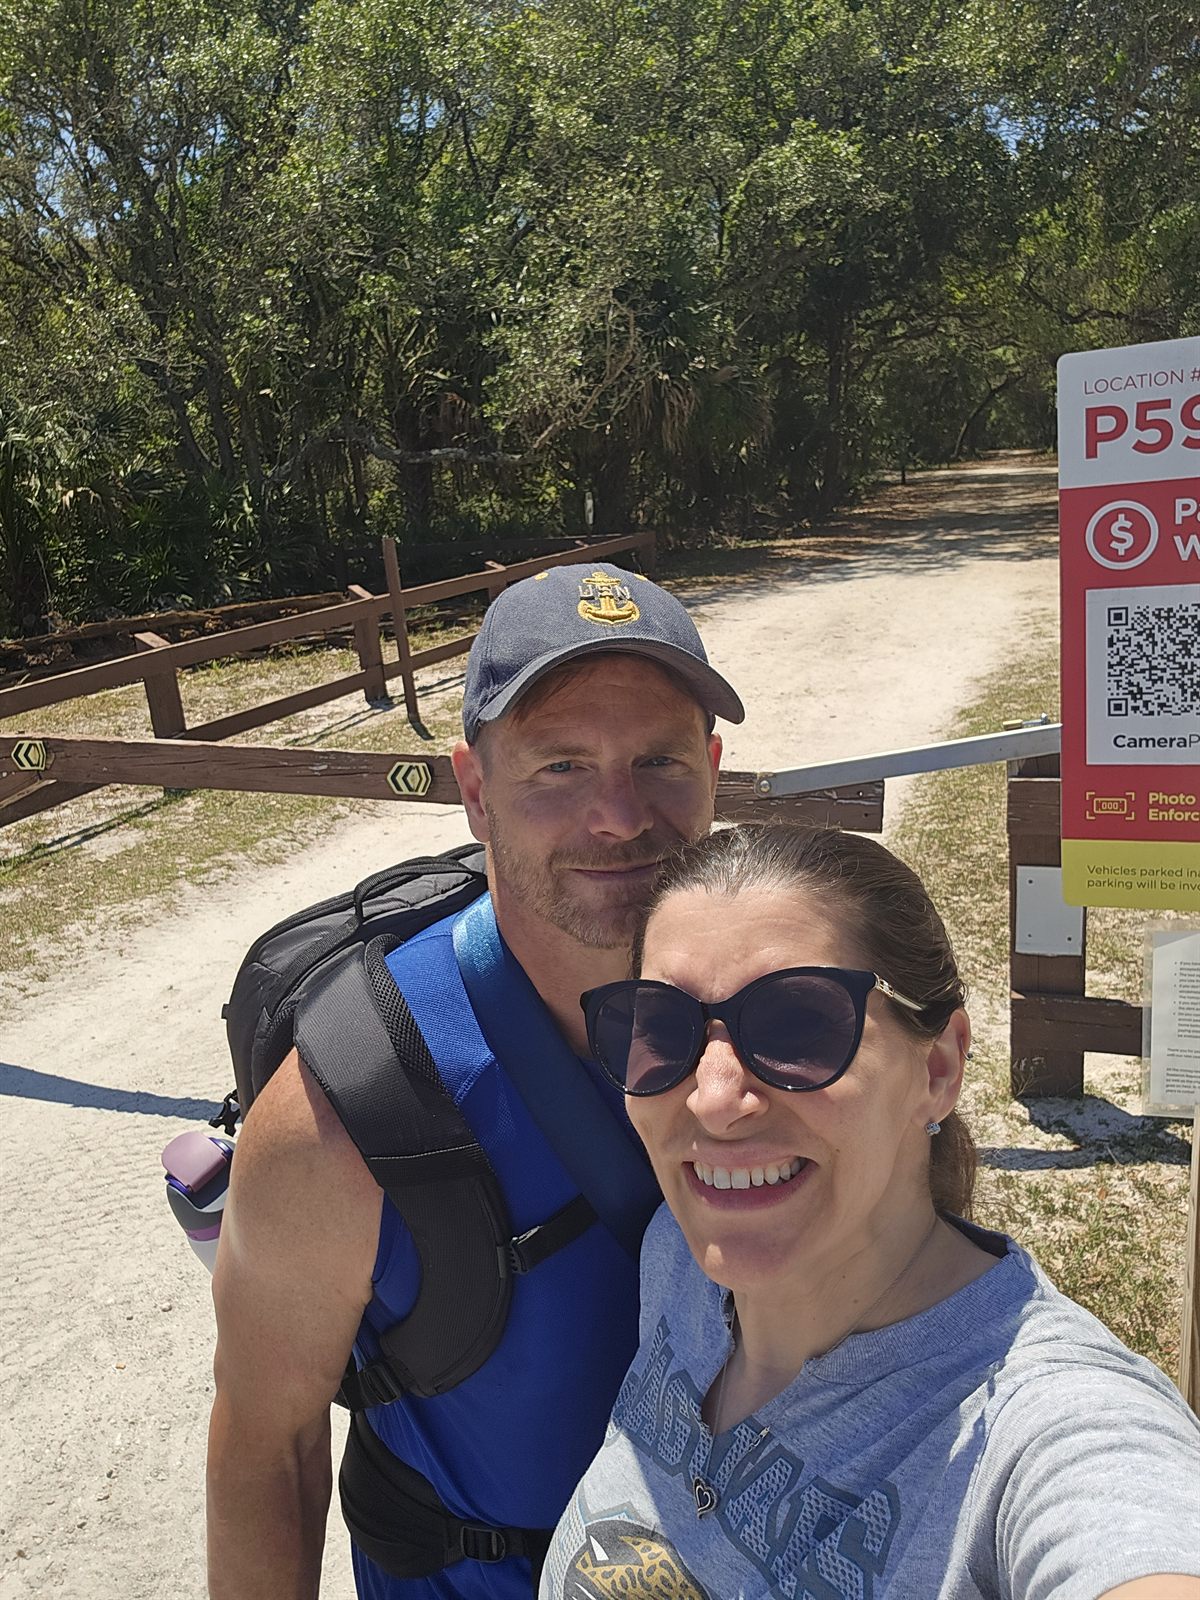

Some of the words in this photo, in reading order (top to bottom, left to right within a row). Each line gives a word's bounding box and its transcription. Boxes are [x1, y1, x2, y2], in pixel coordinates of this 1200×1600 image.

[1083, 368, 1184, 395] LOCATION
[1174, 498, 1200, 525] P
[1148, 792, 1196, 805] Photo
[1087, 864, 1137, 876] Vehicles
[1140, 866, 1183, 880] parked
[1087, 878, 1133, 890] parking
[1136, 879, 1157, 889] will
[1160, 880, 1176, 890] be
